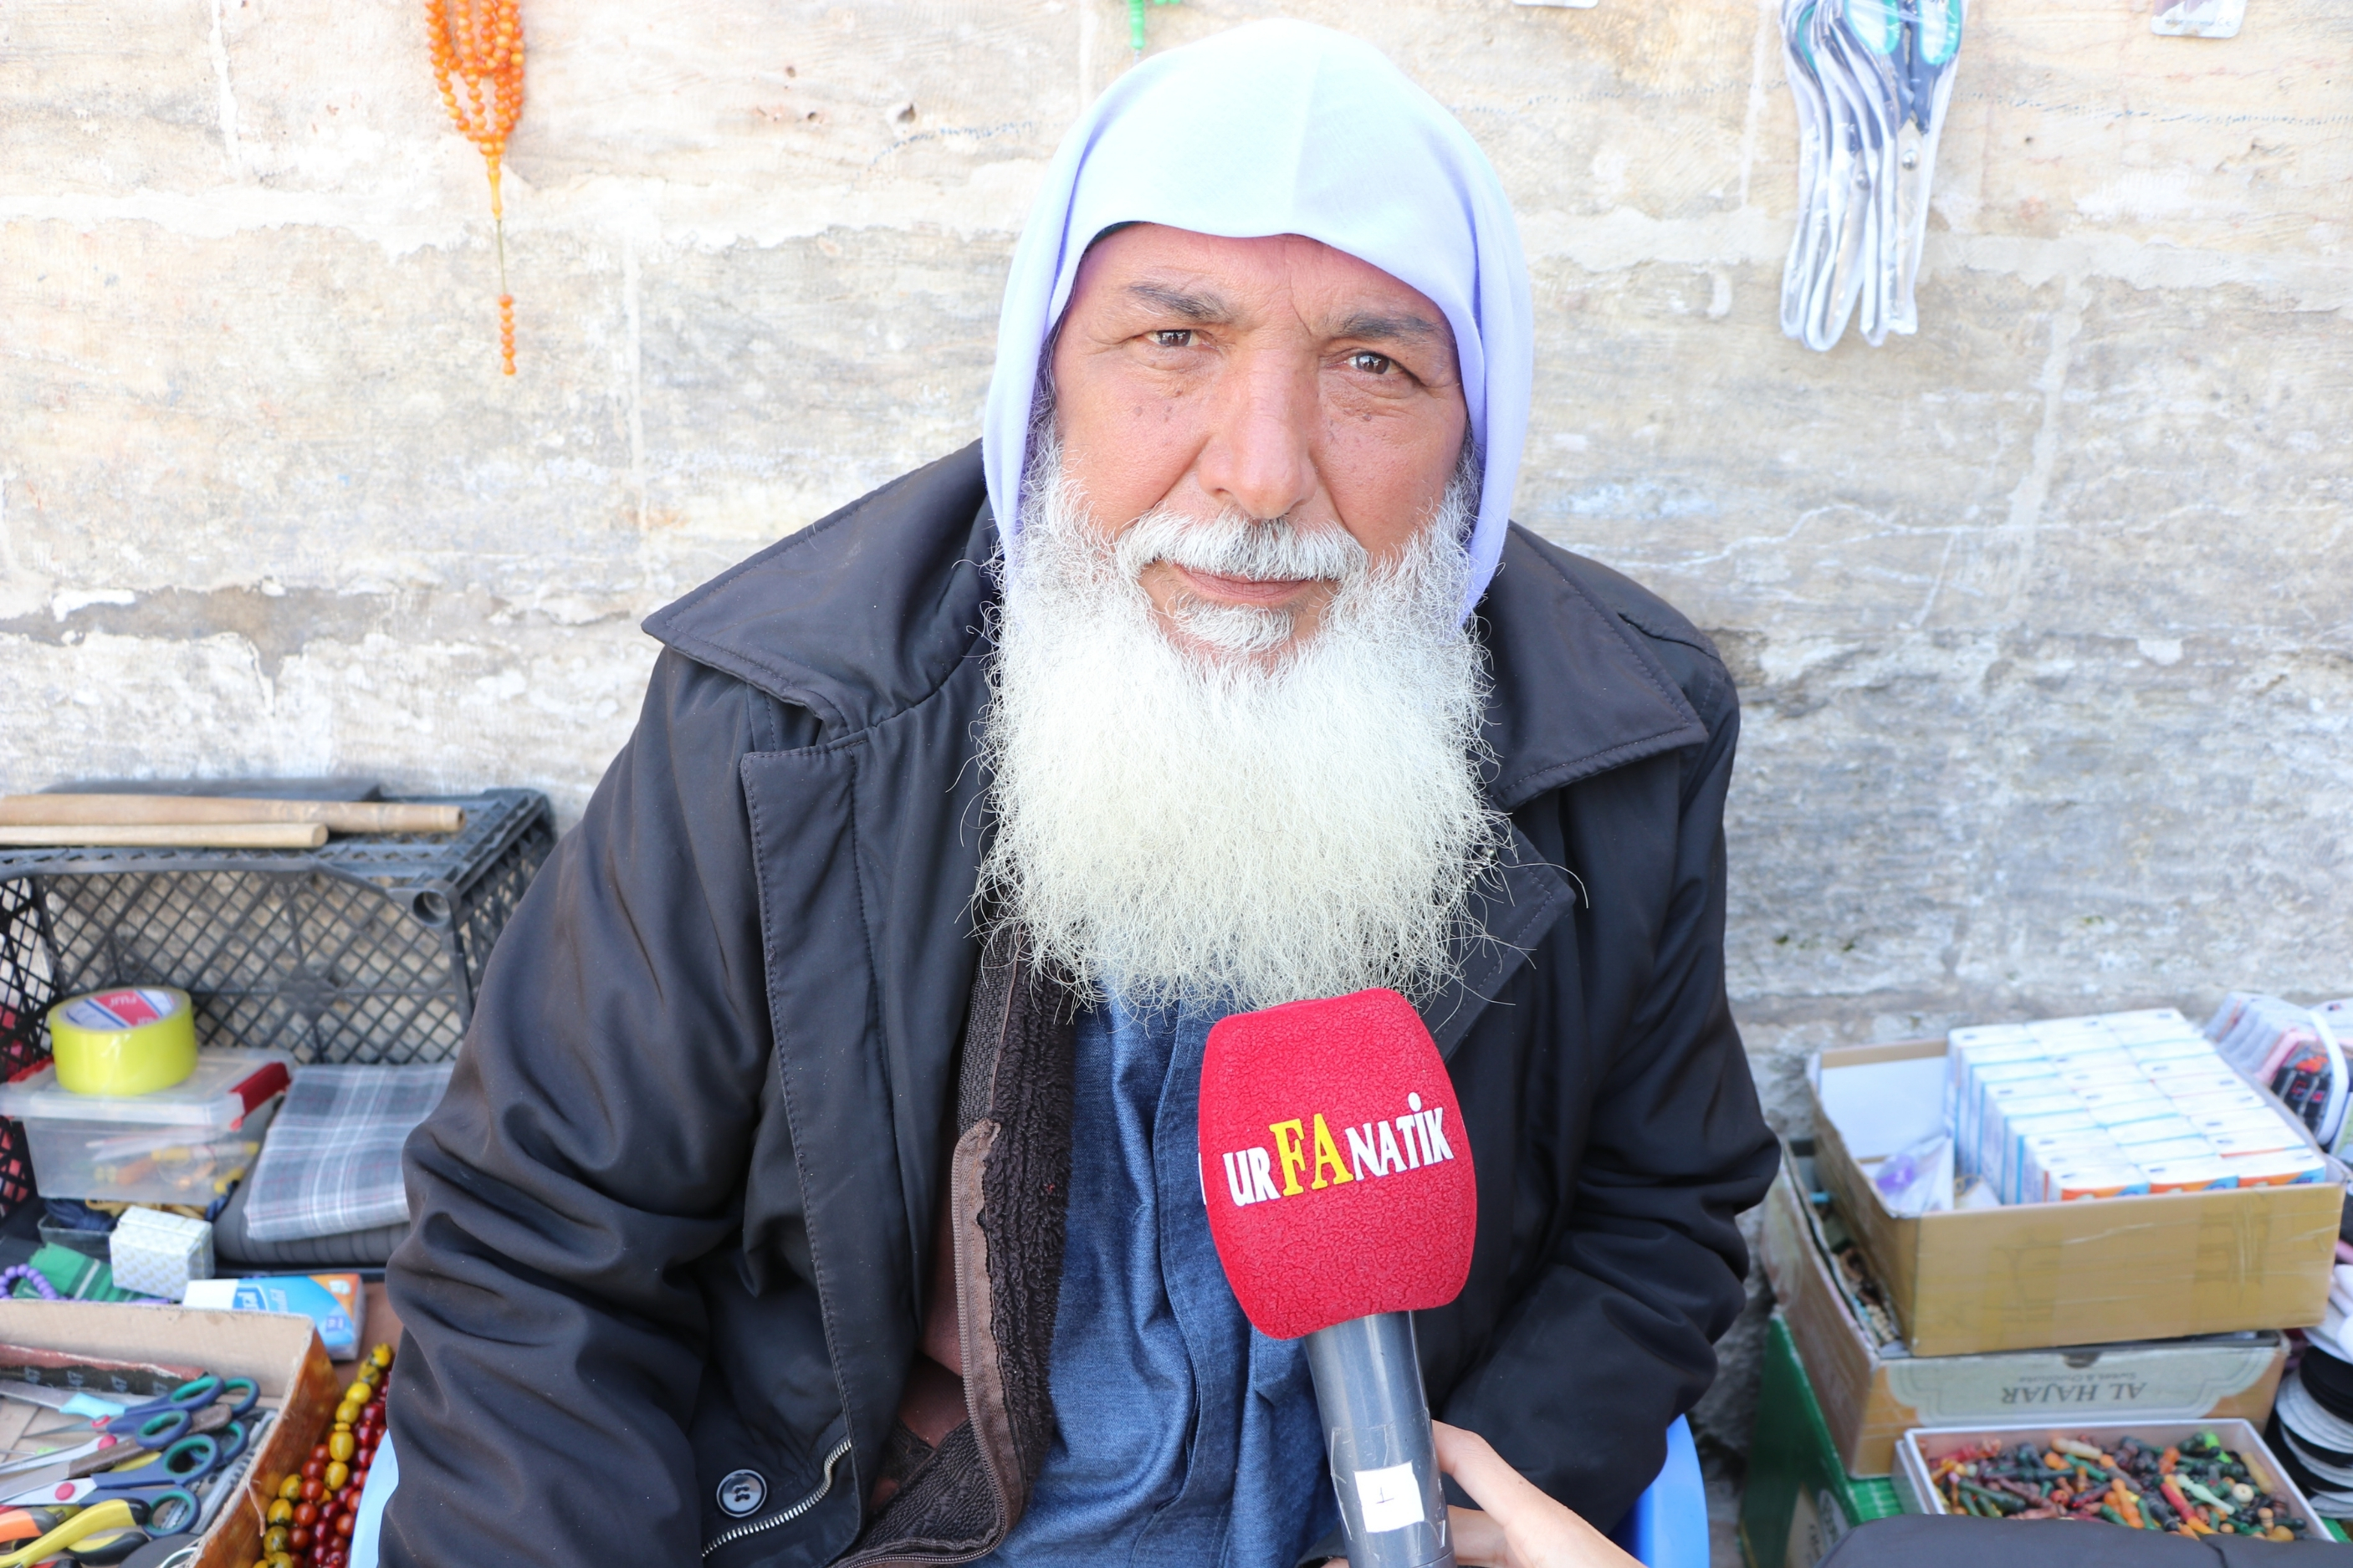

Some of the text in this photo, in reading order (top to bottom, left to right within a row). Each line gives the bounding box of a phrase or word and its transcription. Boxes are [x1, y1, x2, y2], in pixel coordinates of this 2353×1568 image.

[1222, 1091, 1455, 1207] URFANATİK
[2001, 1382, 2147, 1404] AL HAJAR
